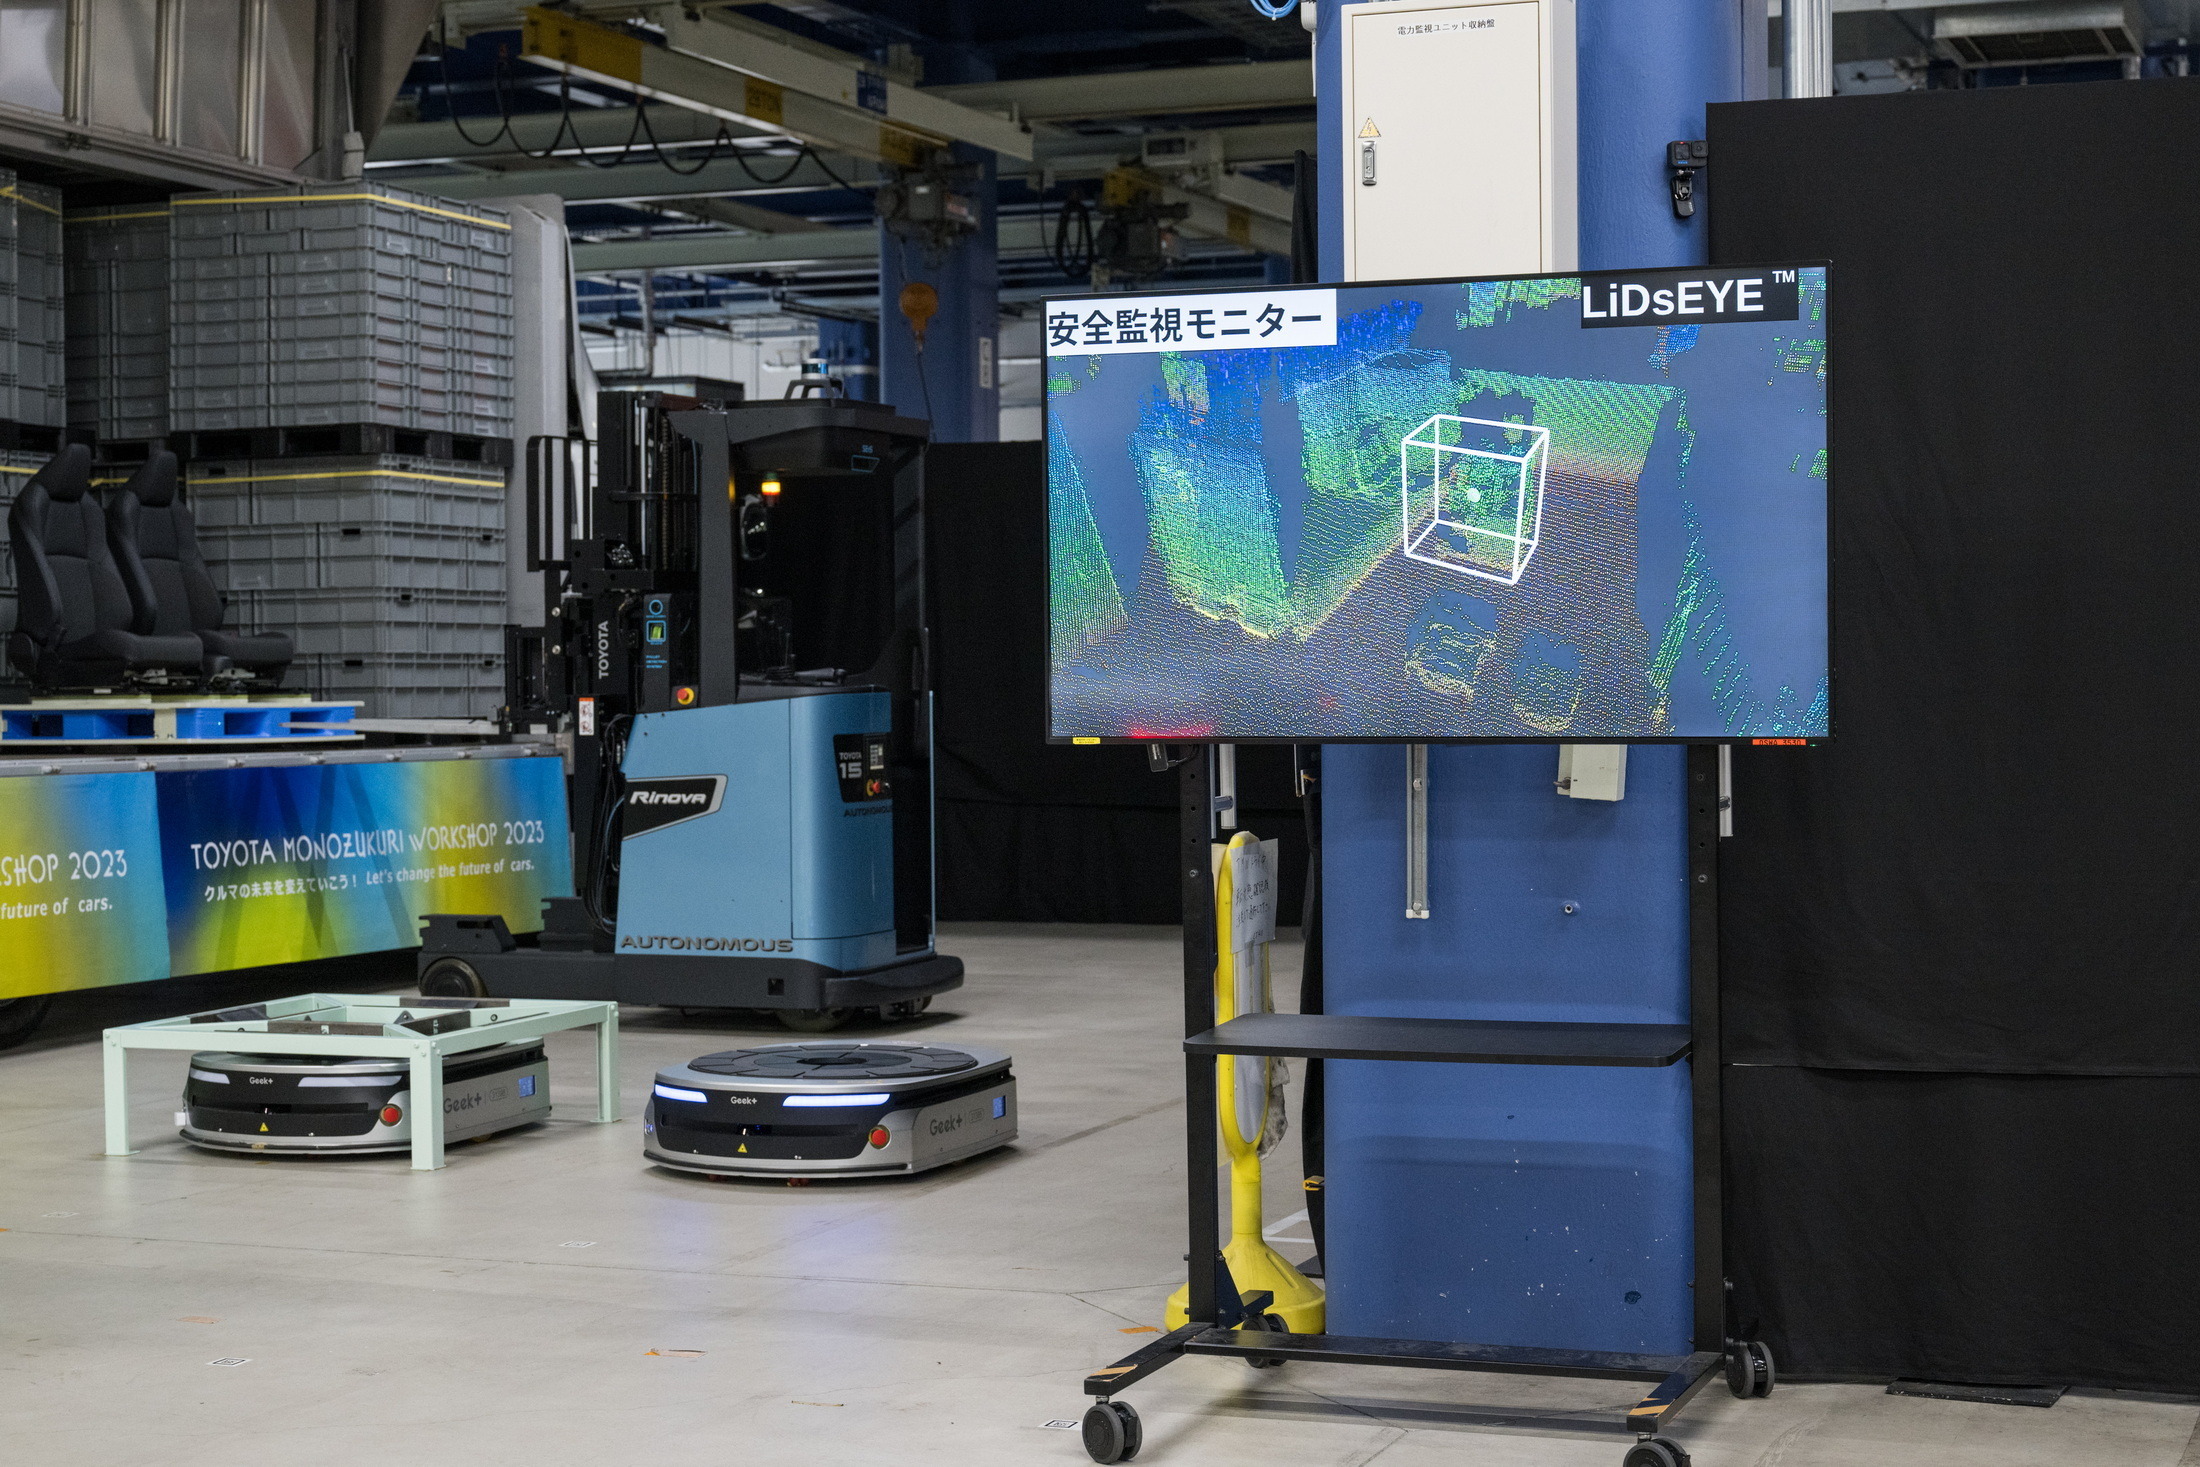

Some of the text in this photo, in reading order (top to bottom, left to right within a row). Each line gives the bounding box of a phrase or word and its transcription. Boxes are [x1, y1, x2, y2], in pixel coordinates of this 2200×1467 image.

[1397, 18, 1495, 36] 電力監視ユニット収納盤
[1583, 278, 1764, 319] LiDsEYE
[1048, 303, 1322, 347] 安全監視モニター
[598, 620, 609, 680] TOYOTA
[839, 762, 863, 779] 15
[190, 820, 545, 870] TOYOTA MONOZUKURI WORKSHOP 2023
[0, 849, 127, 887] SHOP 2023
[366, 870, 393, 886] Let's
[396, 867, 435, 884] change
[438, 864, 455, 879] the
[459, 862, 491, 878] future
[493, 858, 505, 874] of
[510, 859, 535, 872] cars.
[1, 897, 113, 920] future of cars.
[620, 935, 793, 952] AUTONOMOUS
[249, 1076, 273, 1085] Geek+
[444, 1093, 482, 1114] Geek+
[730, 1096, 757, 1105] Geek+
[929, 1113, 963, 1136] Geek+
